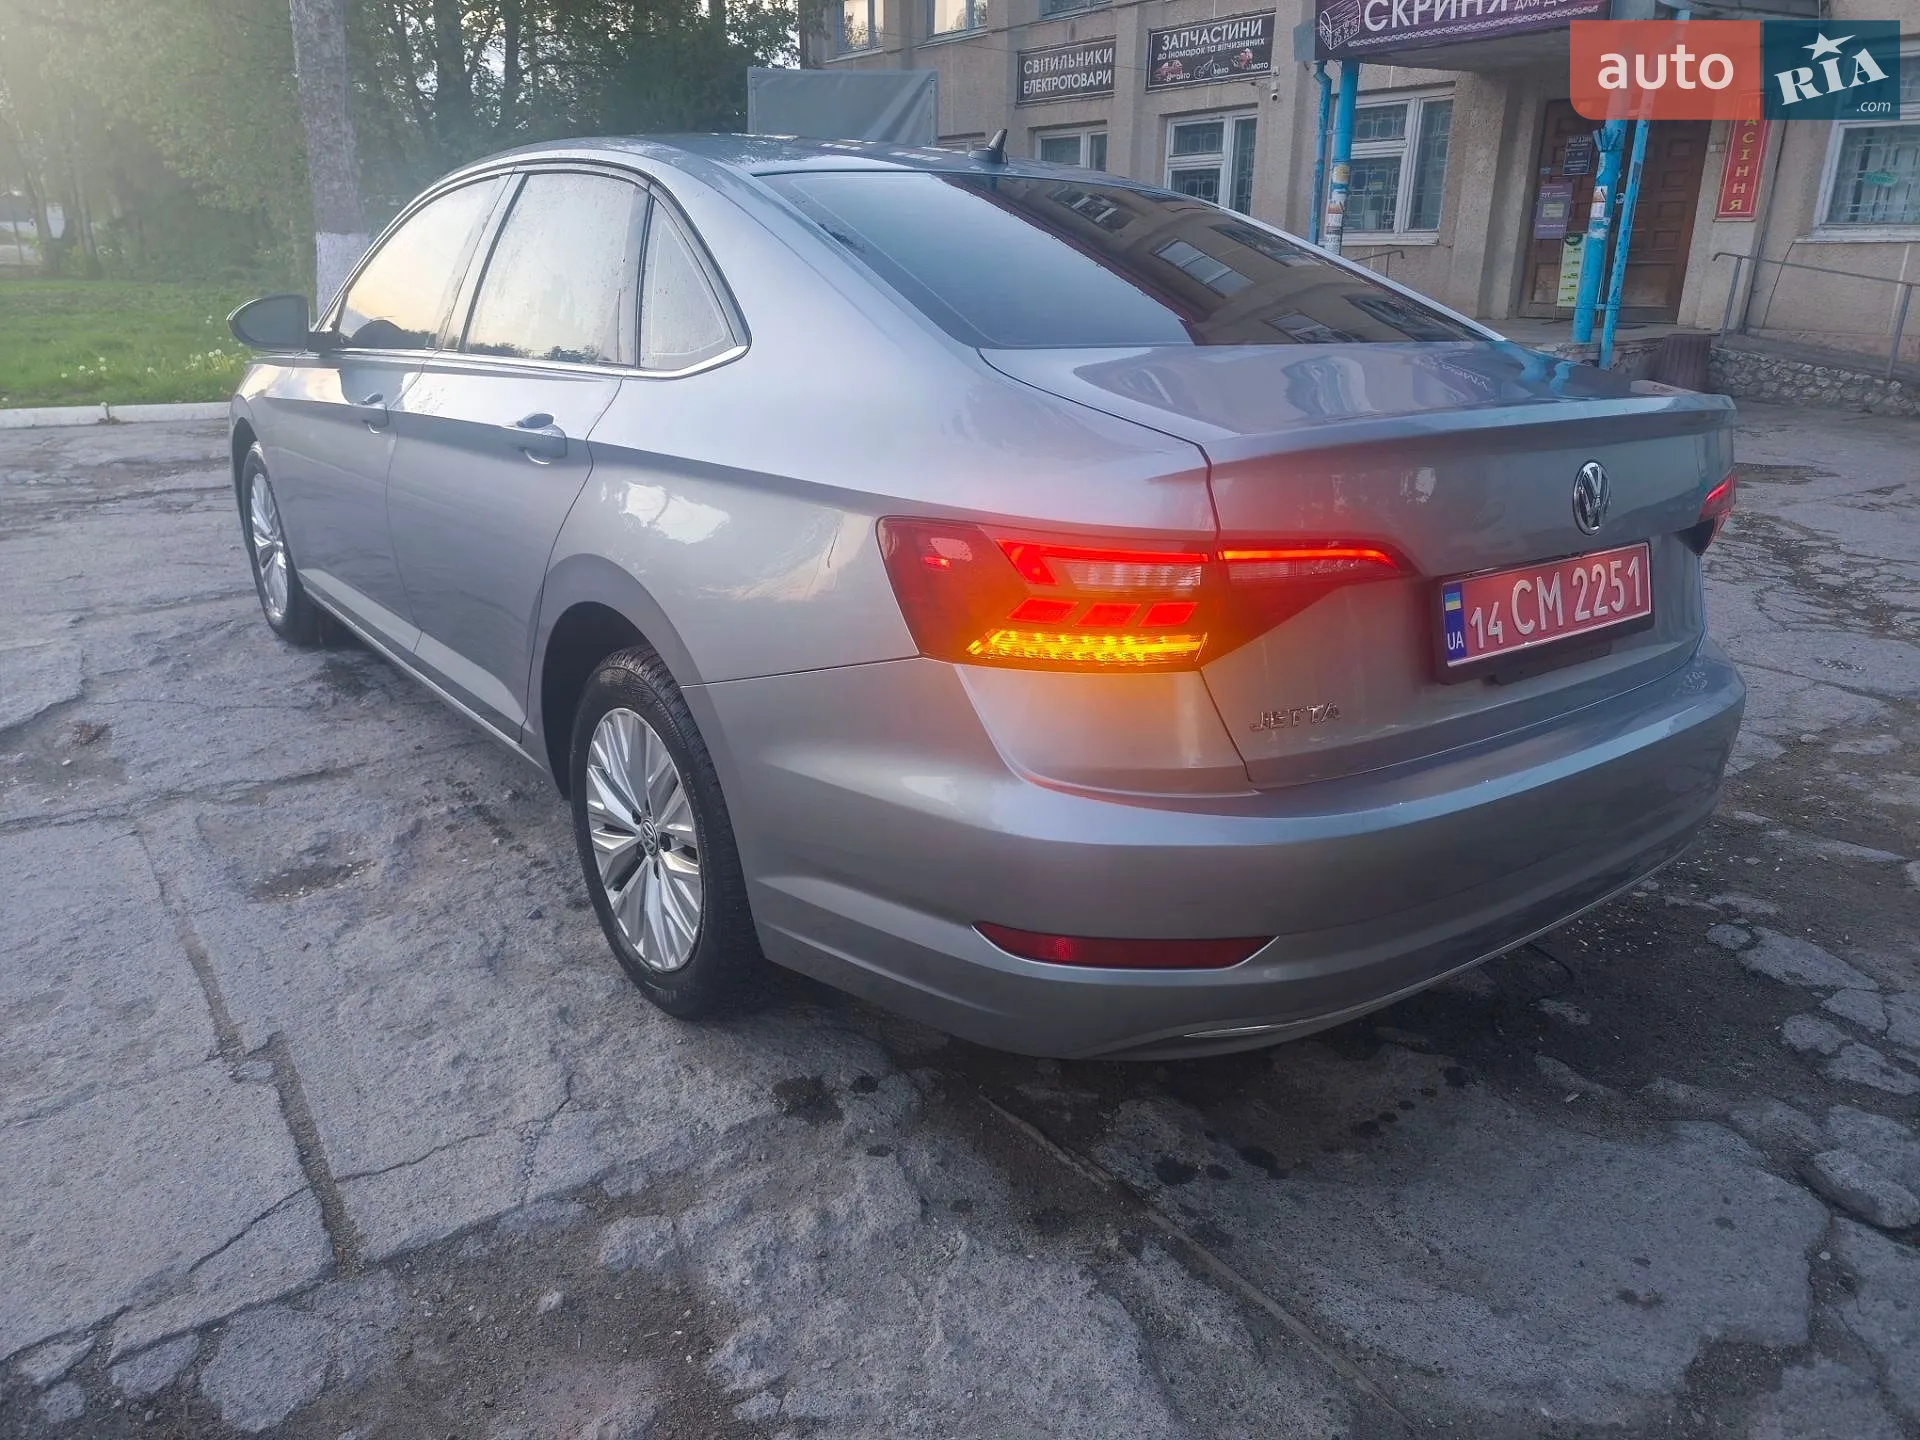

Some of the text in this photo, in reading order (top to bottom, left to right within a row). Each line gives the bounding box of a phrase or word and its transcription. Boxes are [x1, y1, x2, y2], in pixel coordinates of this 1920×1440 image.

[1162, 19, 1262, 51] ЗАПЧАСТИНИ
[1024, 47, 1113, 75] СВІТИЛЬНИКИ
[1023, 69, 1112, 94] ЕЛЕКТРОТОВАРИ
[1470, 556, 1642, 649] 14 CM 2251
[1447, 631, 1465, 650] UA
[1249, 702, 1341, 732] JETTA
